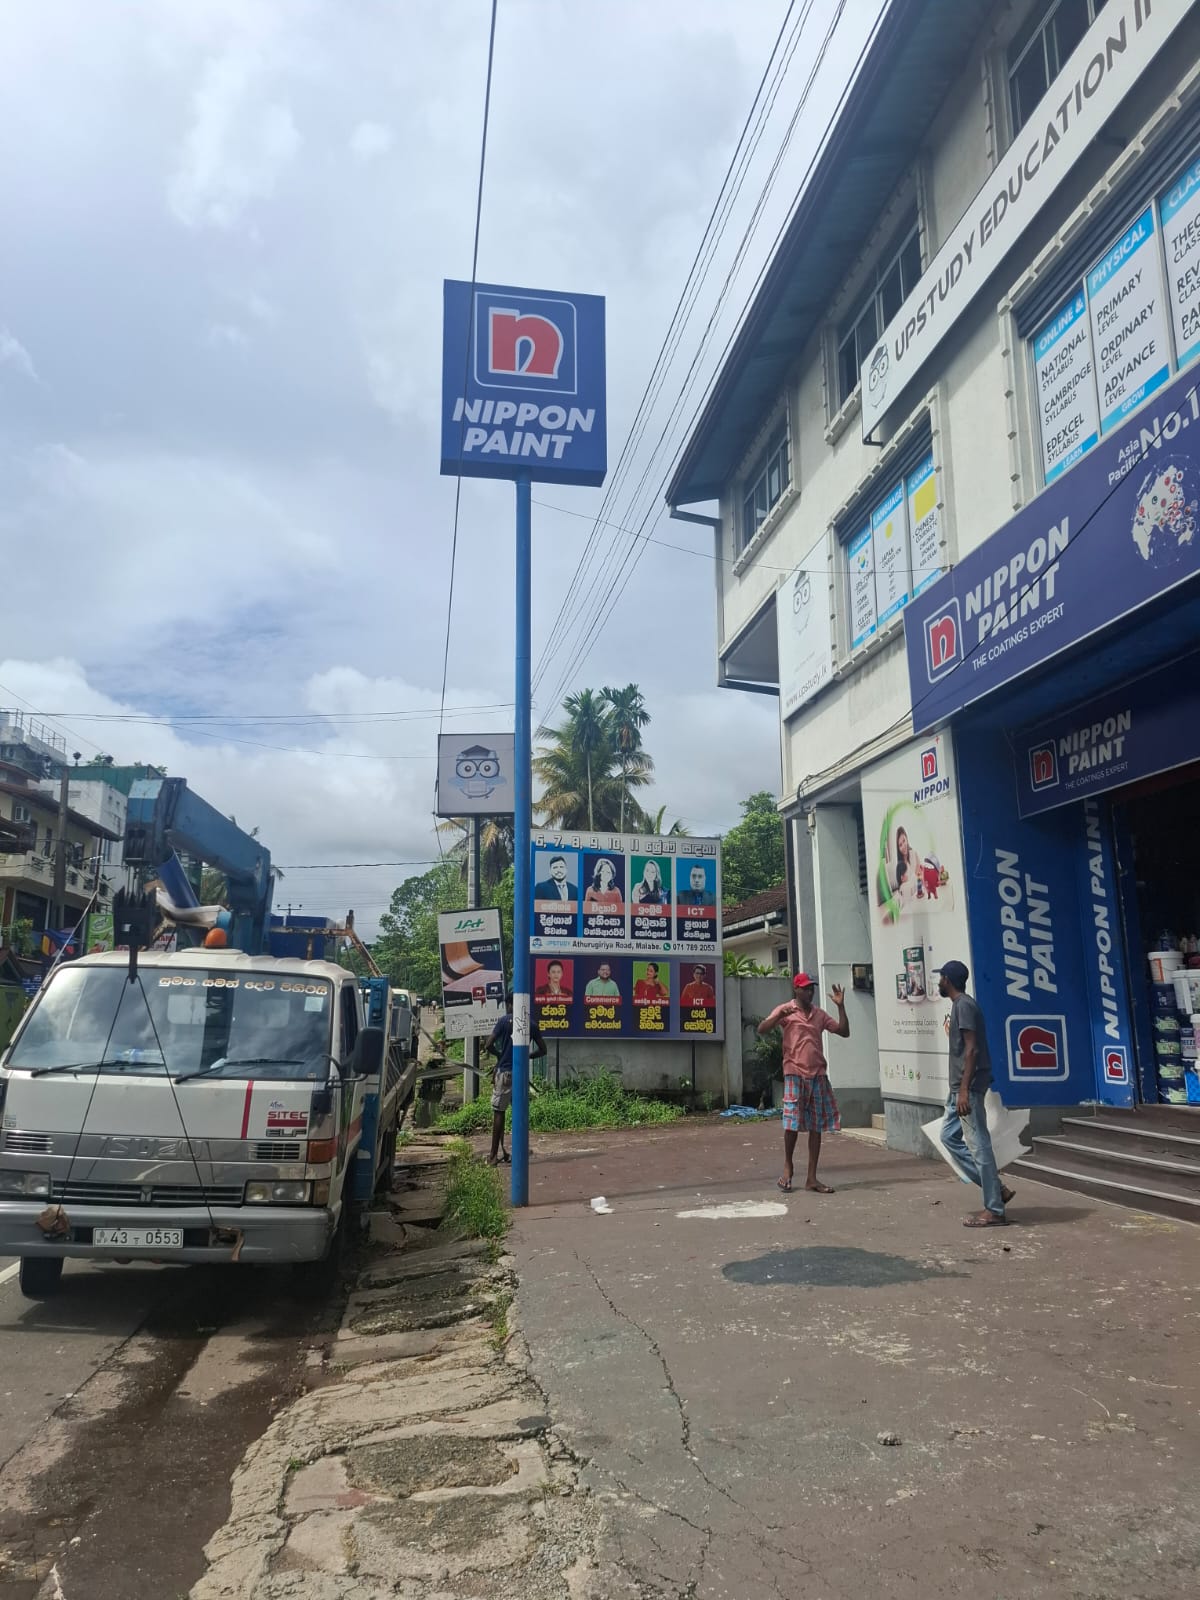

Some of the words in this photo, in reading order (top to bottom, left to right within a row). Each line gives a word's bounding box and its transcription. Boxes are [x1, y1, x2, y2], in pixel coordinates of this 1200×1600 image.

[894, 231, 975, 362] UPSTUDY
[979, 16, 1127, 249] EDUCATION
[1091, 224, 1146, 289] PHYSICAL
[1096, 268, 1142, 325] PRIMARY
[1039, 306, 1074, 350] ONLINE
[1098, 312, 1120, 336] LEVEL
[1100, 299, 1155, 361] ORDINARY
[1041, 329, 1087, 381] NATIONAL
[1101, 350, 1123, 374] LEVEL
[1104, 340, 1155, 397] ADVANCE
[1042, 355, 1074, 392] SYLLABUS
[1044, 361, 1092, 414] CAMBRIDGE
[1045, 391, 1077, 426] SYLLABUS
[1105, 384, 1126, 408] LEVEL
[1121, 386, 1146, 413] GROW
[452, 398, 595, 432] NIPPON
[463, 427, 573, 459] PAINT
[1046, 412, 1084, 453] EDEXCEL
[1048, 431, 1080, 464] SYLLABUS
[1063, 445, 1083, 468] LEARN
[1117, 438, 1140, 463] Asia
[1108, 452, 1140, 486] Pacific
[914, 512, 935, 537] CHINESE
[965, 516, 1069, 622] NIPPON
[978, 562, 1060, 646] PAINT
[972, 653, 987, 671] THE
[988, 627, 1029, 661] COATINGS
[1030, 602, 1065, 635] EXPERT
[1060, 710, 1131, 757] NIPPON
[1069, 735, 1125, 776] PAINT
[914, 776, 950, 803] NIPPON
[1065, 782, 1076, 790] THE
[1076, 770, 1105, 786] COATINGS
[1105, 761, 1129, 776] EXPERT
[1084, 799, 1106, 897] PAINT
[688, 907, 705, 916] ICT
[994, 848, 1031, 1001] NIPPON
[572, 940, 614, 949] Athurugiriya
[616, 941, 634, 950] Road,
[636, 942, 661, 950] Malabe.
[673, 943, 684, 951] 071
[686, 943, 698, 951] 789
[700, 943, 716, 952] 2053
[1025, 873, 1058, 994] PAINT
[1093, 904, 1120, 1040] NIPPON
[585, 996, 620, 1004] Commerce
[693, 998, 705, 1006] ICT
[267, 1111, 309, 1119] SITEC
[265, 1128, 307, 1138] ELF
[110, 1231, 128, 1244] 43
[145, 1232, 180, 1244] 0553
